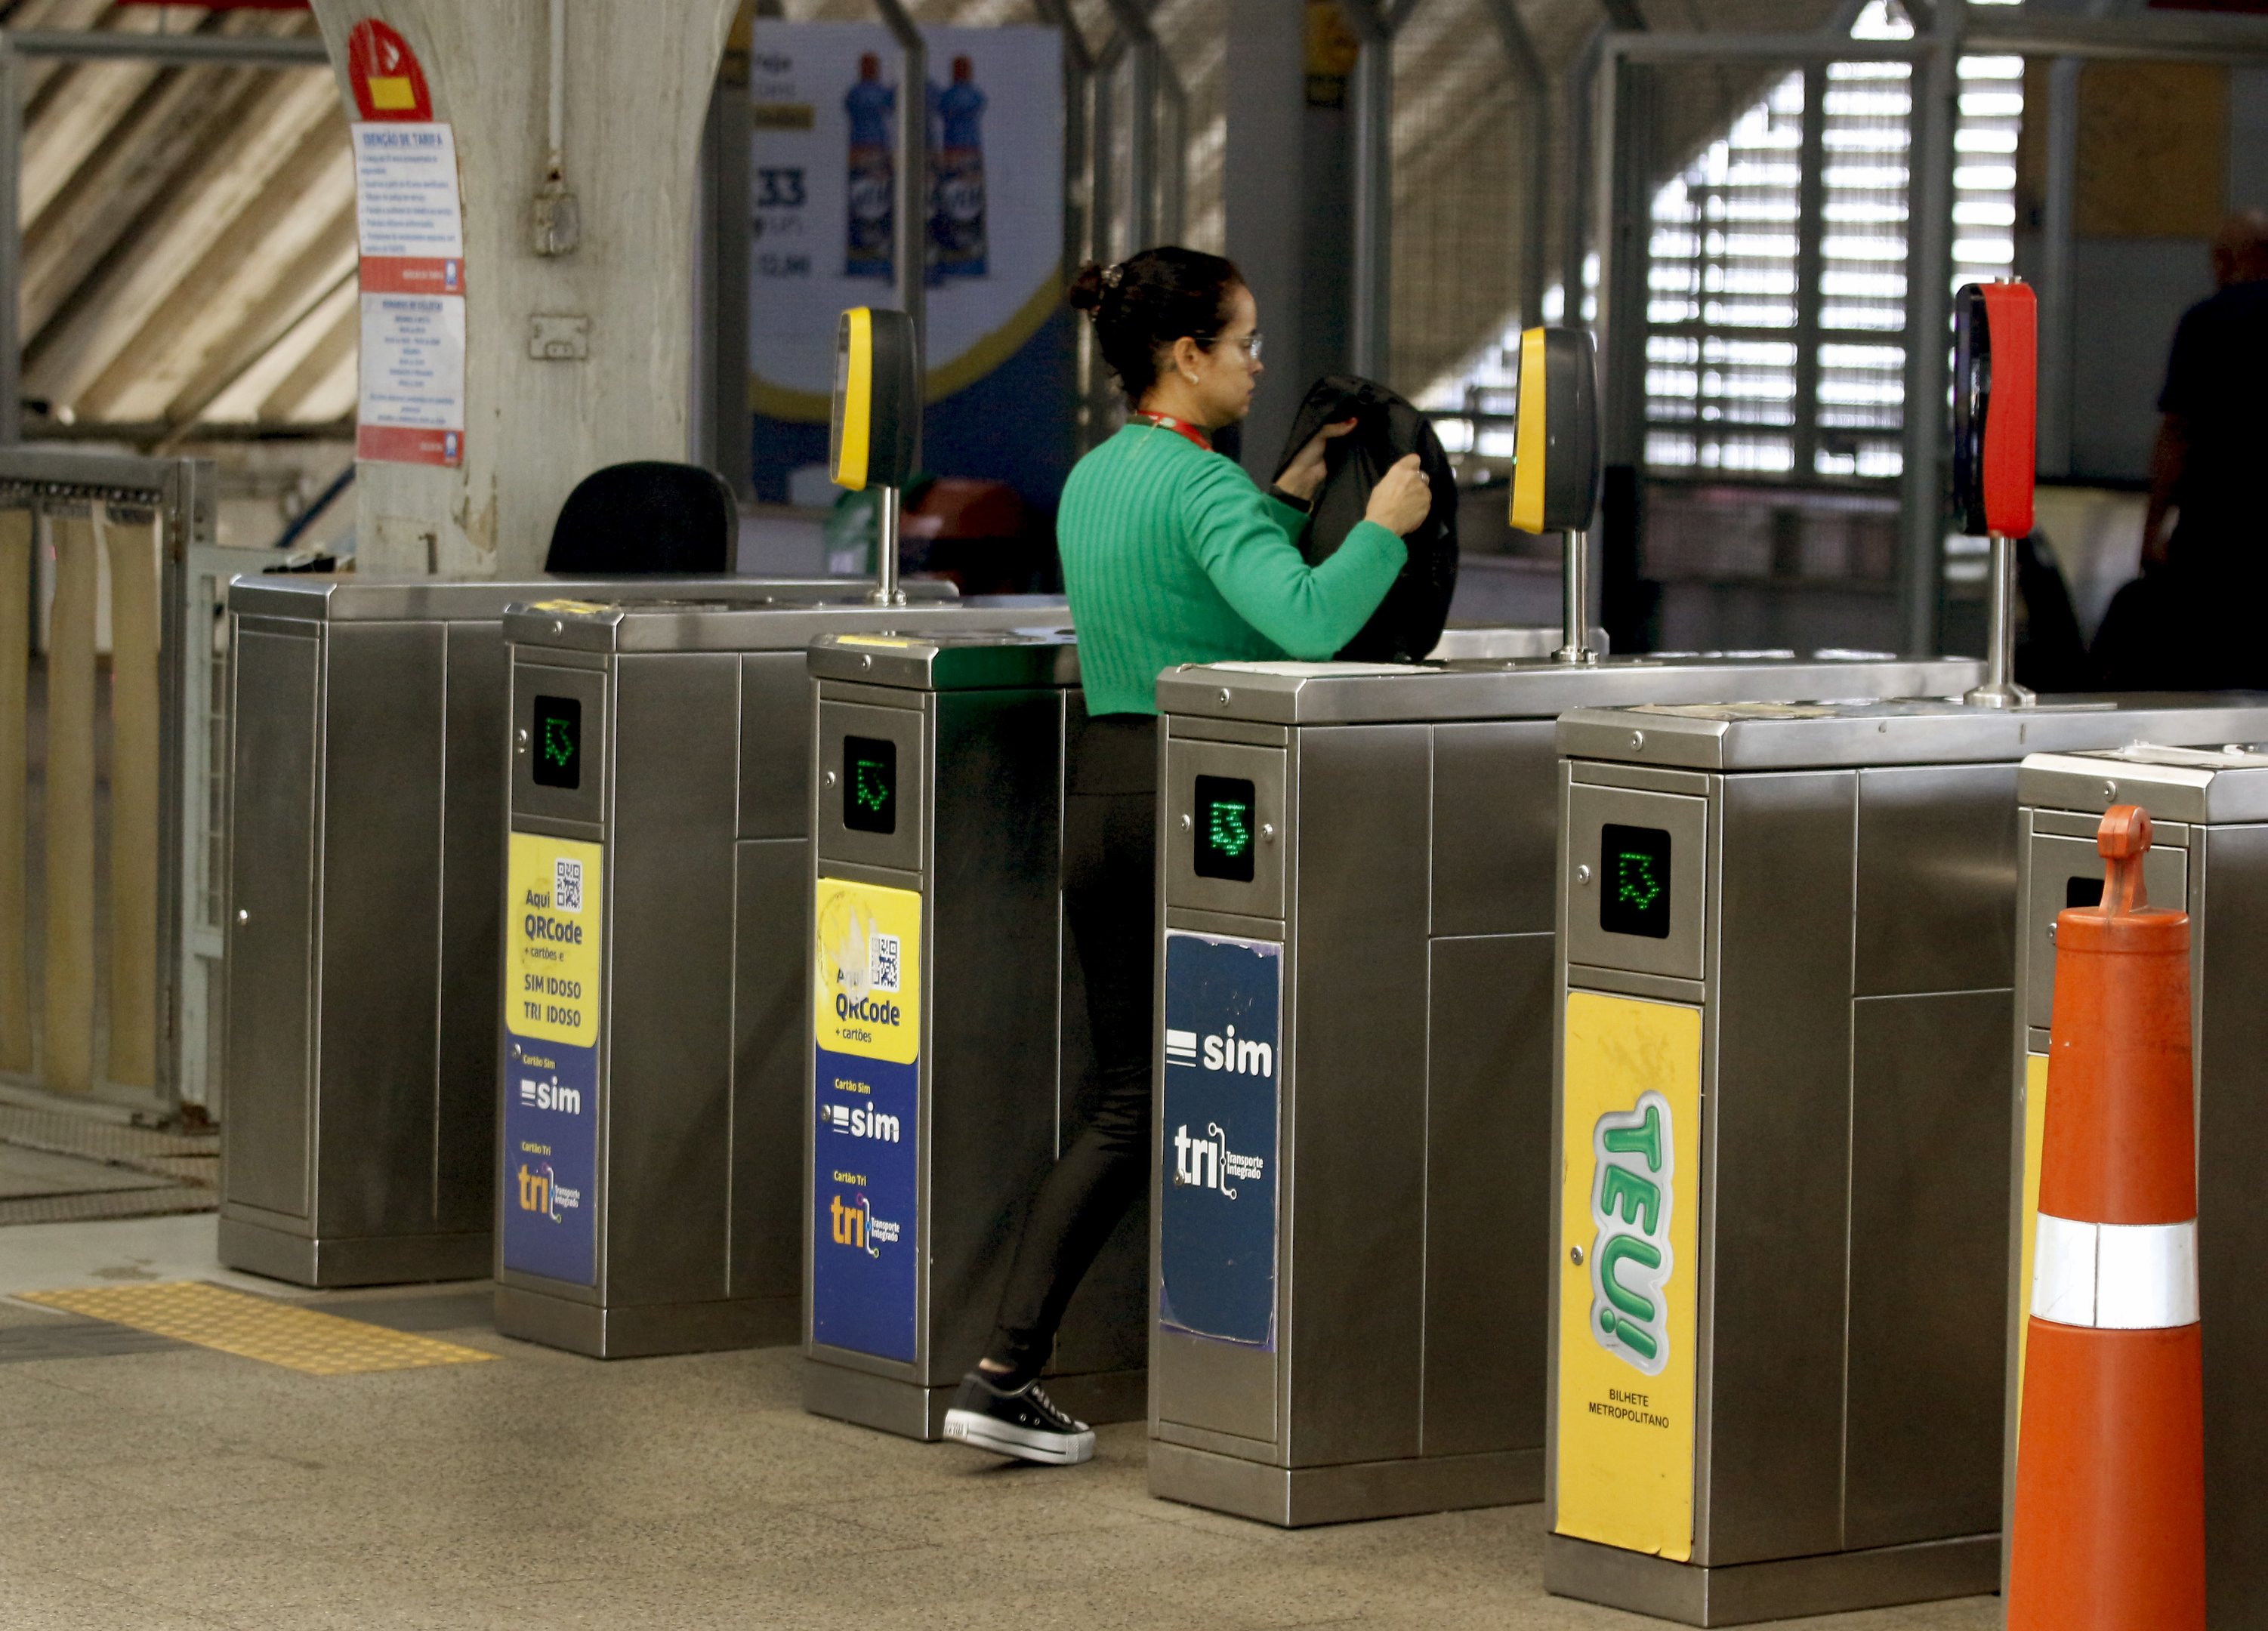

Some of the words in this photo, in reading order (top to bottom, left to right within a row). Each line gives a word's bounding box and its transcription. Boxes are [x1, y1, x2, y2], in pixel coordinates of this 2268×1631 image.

[526, 889, 550, 910] Aqui
[525, 914, 582, 945] QRCode
[531, 948, 557, 960] cartões
[559, 952, 564, 961] e
[524, 973, 545, 993] SIM
[547, 977, 582, 1000] IDOSO
[524, 1001, 542, 1022] TRI
[547, 1006, 581, 1027] IDOSO
[836, 993, 900, 1026] QRCode
[842, 1028, 872, 1043] cartões
[523, 1054, 543, 1068] Cartão
[544, 1058, 556, 1069] Sim
[1203, 1025, 1273, 1078] sim
[537, 1075, 581, 1115] sim
[835, 1078, 856, 1093] Cartão
[858, 1082, 871, 1094] Sim
[851, 1101, 899, 1143] sim
[522, 1141, 542, 1155] Cartão
[543, 1145, 551, 1156] Tri
[1174, 1124, 1217, 1189] tri
[1226, 1151, 1264, 1169] Transporte
[834, 1170, 856, 1185] Cartão
[856, 1173, 866, 1186] Tri
[1227, 1164, 1261, 1180] Integrado
[518, 1164, 548, 1213] tri
[554, 1185, 580, 1199] Transporte
[554, 1195, 579, 1208] Integrado
[831, 1195, 864, 1248] tri
[871, 1216, 900, 1233] Transporte
[871, 1228, 899, 1243] Integrado
[1600, 1105, 1662, 1360] TEU!
[1609, 1388, 1649, 1407] BILHETE
[1588, 1401, 1670, 1429] METROPOLITANO
